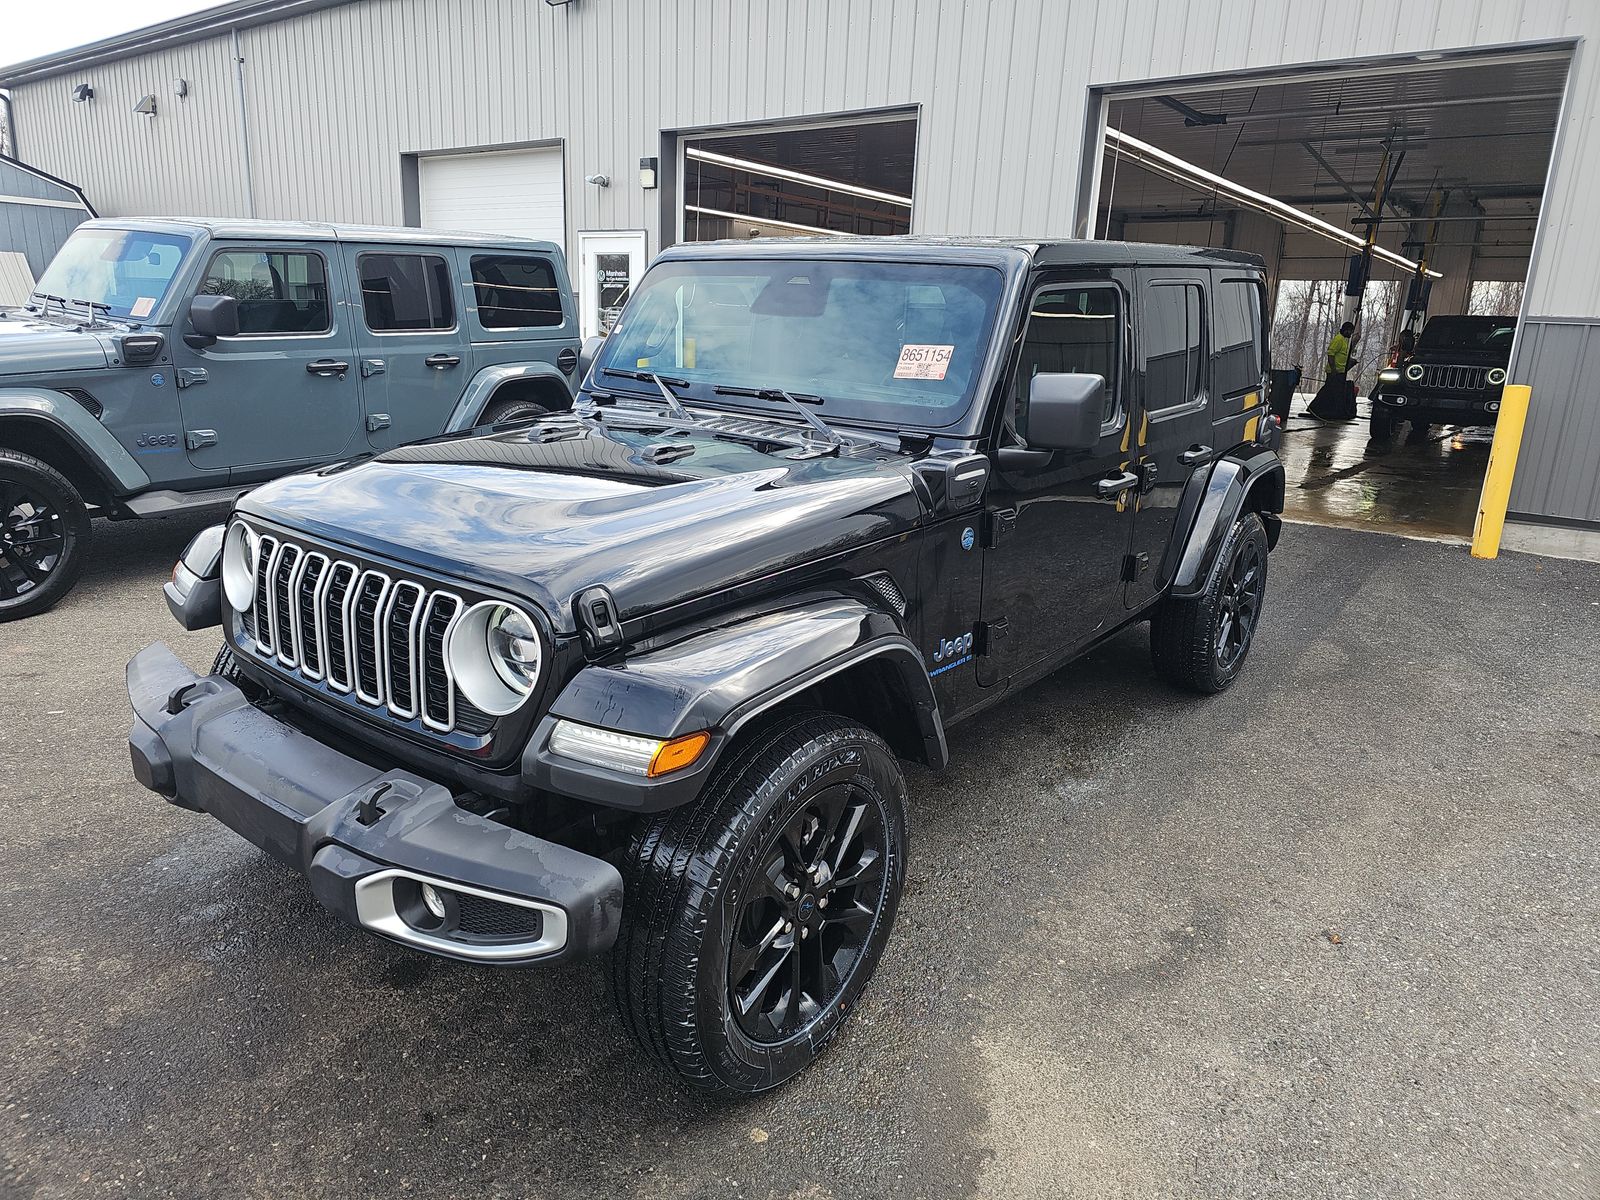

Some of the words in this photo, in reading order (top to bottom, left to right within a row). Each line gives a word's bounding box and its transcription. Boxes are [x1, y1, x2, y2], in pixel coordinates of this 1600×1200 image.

[901, 348, 951, 362] 8651154
[136, 432, 177, 447] Jeep
[934, 632, 973, 662] Jeep
[928, 657, 966, 677] WRANGLER
